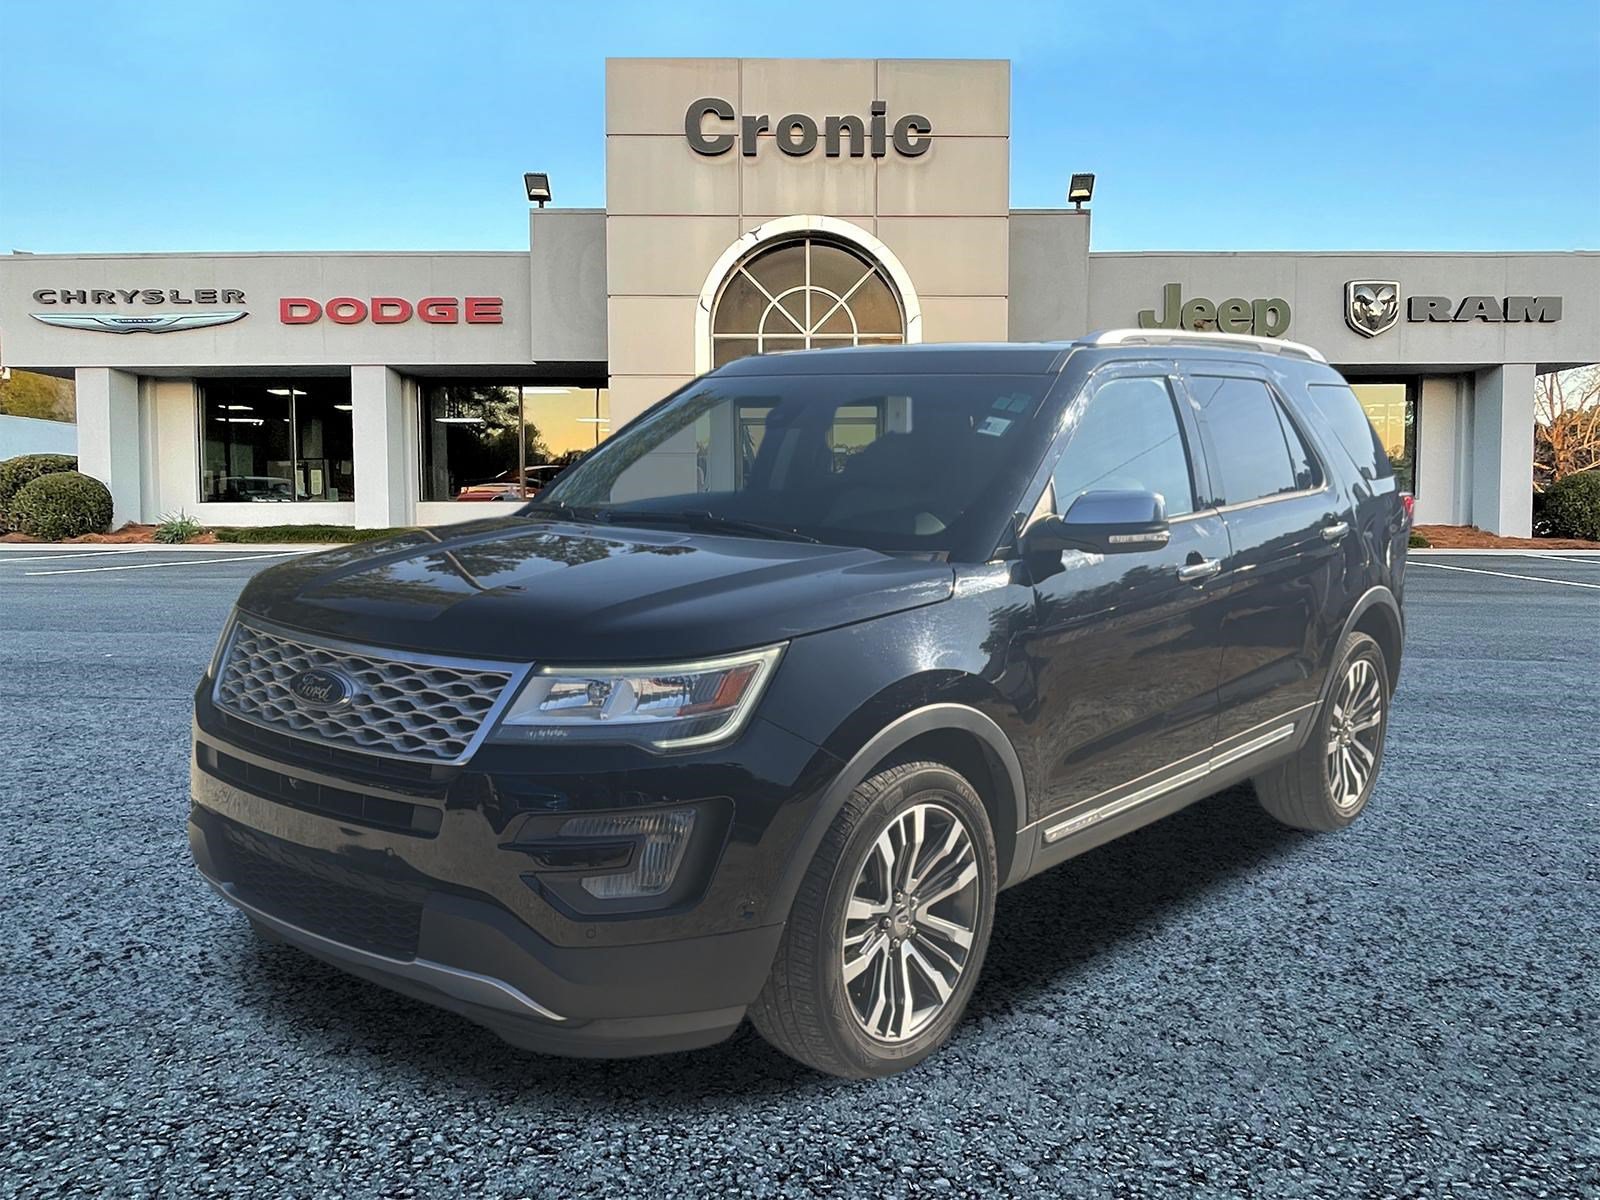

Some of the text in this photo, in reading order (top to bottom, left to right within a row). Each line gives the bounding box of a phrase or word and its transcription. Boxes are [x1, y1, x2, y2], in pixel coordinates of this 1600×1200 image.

[685, 97, 932, 157] Cronic
[32, 289, 246, 304] CHRYSLER
[1138, 283, 1291, 337] Jeep
[1407, 296, 1563, 323] RAM
[279, 297, 503, 324] DODGE
[302, 673, 333, 701] Ford
